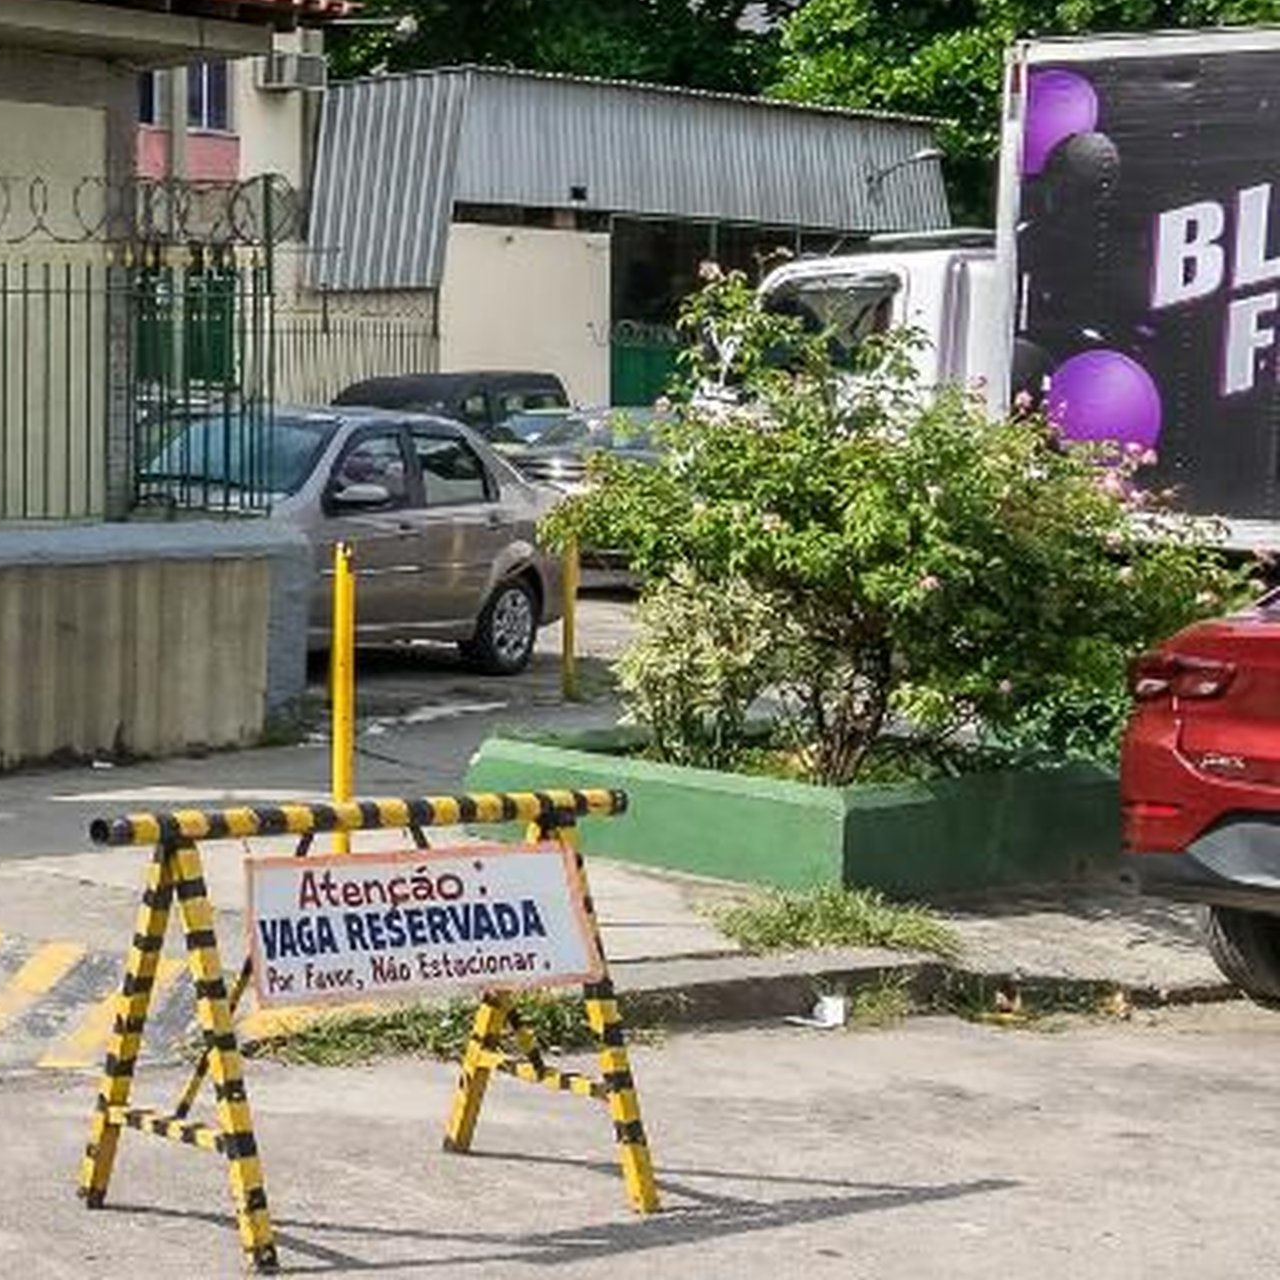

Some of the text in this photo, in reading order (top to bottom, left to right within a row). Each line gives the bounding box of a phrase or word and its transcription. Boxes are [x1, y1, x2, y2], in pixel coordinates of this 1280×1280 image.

[259, 899, 547, 960] VAGA RESERVADA
[267, 966, 294, 993] Por
